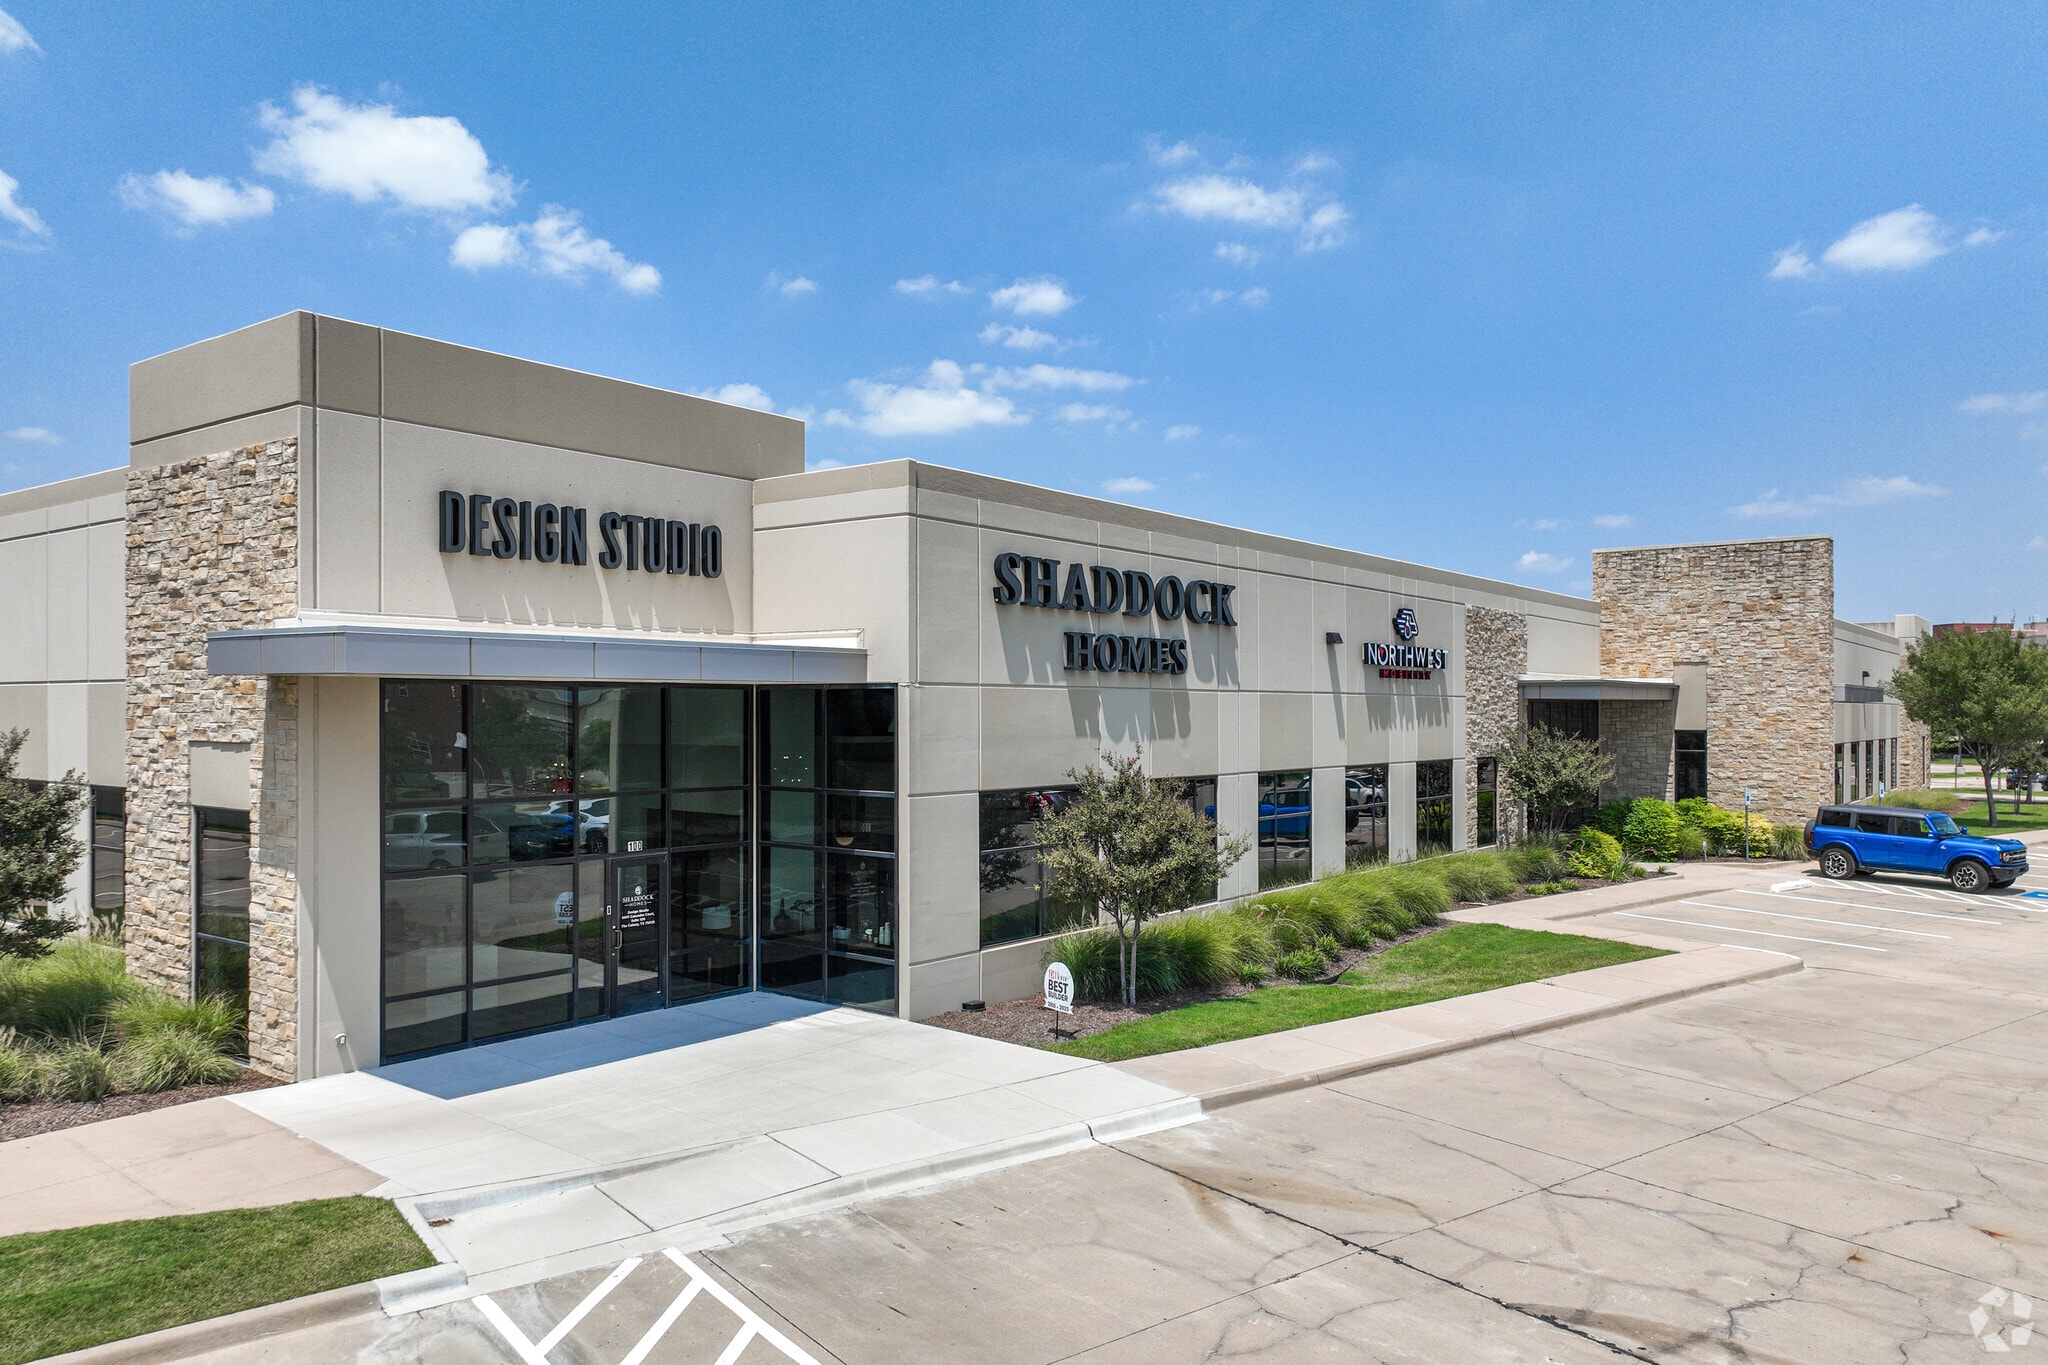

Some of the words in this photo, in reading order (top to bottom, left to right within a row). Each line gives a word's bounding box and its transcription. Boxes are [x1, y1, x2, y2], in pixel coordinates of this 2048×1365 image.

[439, 490, 587, 566] DESIGN
[598, 511, 723, 579] STUDIO
[992, 552, 1238, 626] SHADDOCK
[1063, 631, 1188, 675] HOMES
[1364, 643, 1449, 669] NORTHWEST
[1379, 669, 1431, 680] MOBILITY
[629, 841, 642, 851] 100
[622, 894, 654, 903] SHADDOCK
[1048, 980, 1068, 994] BEST
[1048, 991, 1068, 1002] BUILDER
